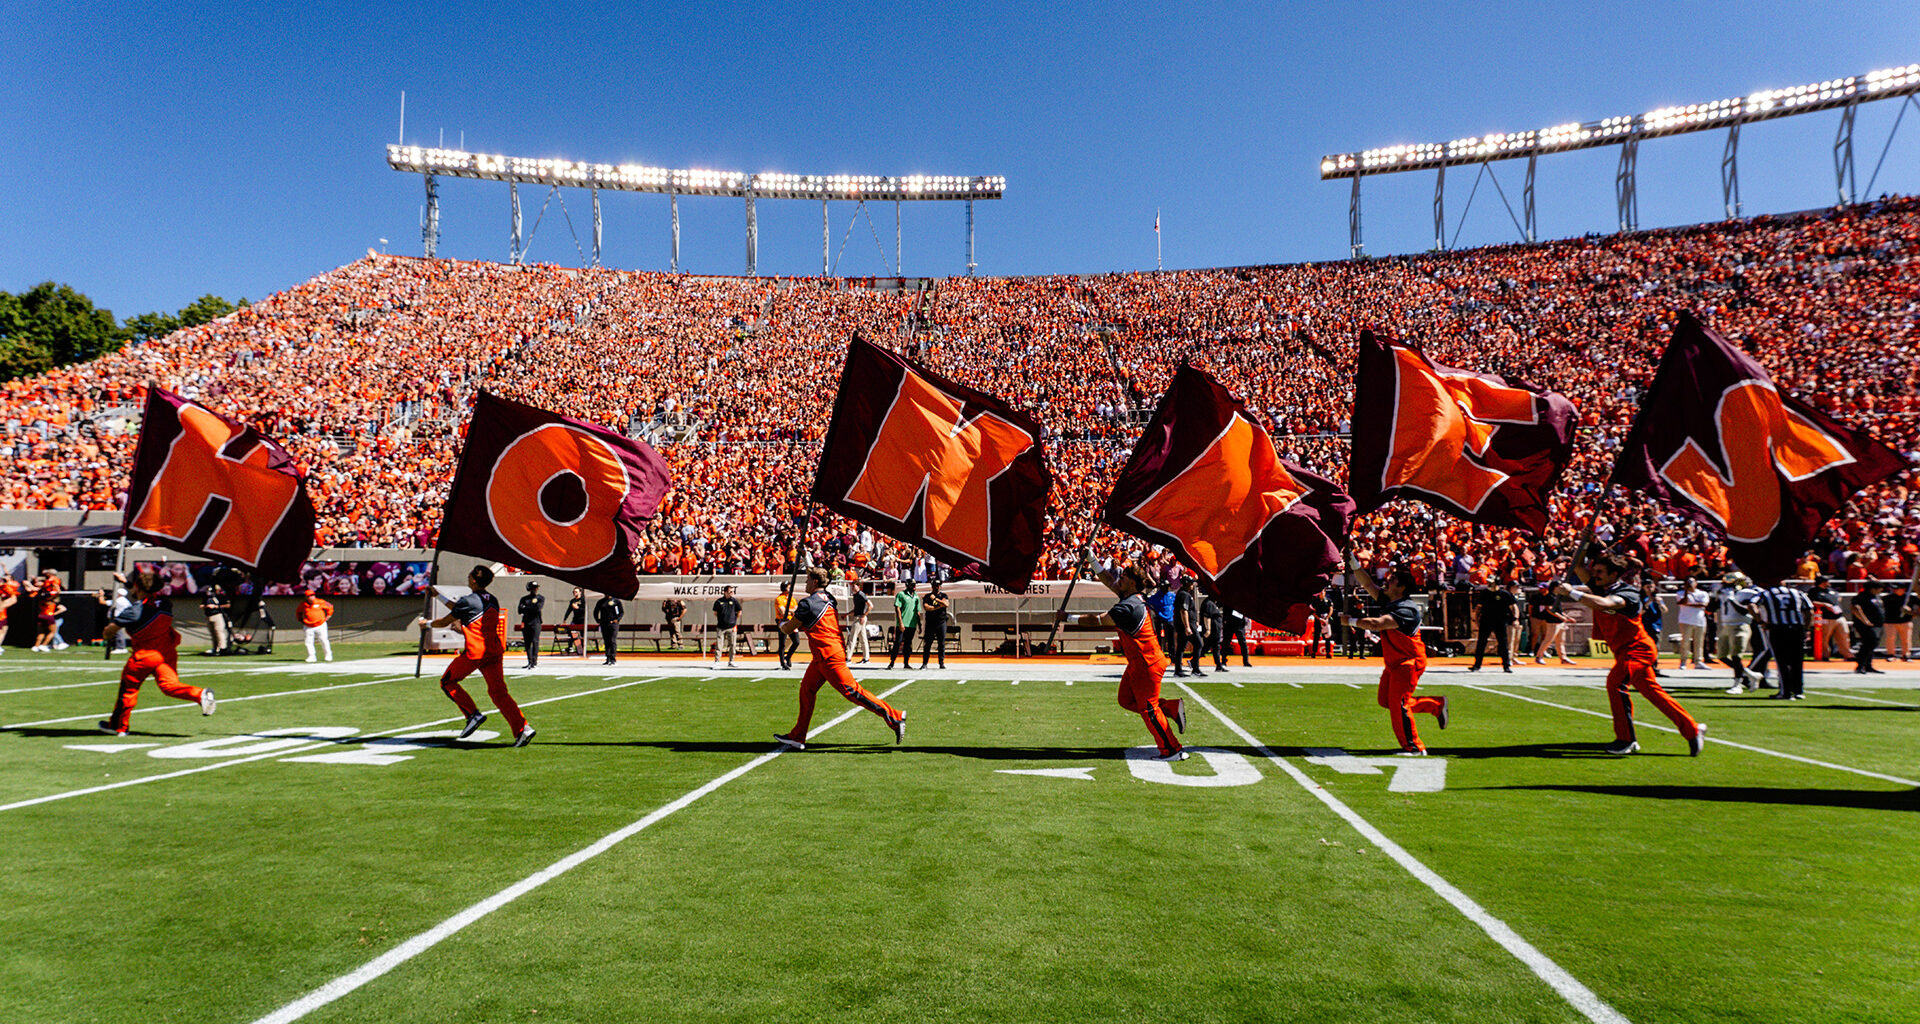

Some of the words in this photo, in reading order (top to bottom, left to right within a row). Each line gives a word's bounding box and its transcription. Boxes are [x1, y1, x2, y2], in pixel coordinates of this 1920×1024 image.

[130, 402, 299, 568] H
[486, 422, 631, 571] O
[1381, 345, 1539, 515] E
[1659, 378, 1857, 543] S
[673, 586, 698, 595] WAKE
[1595, 642, 1609, 654] 10
